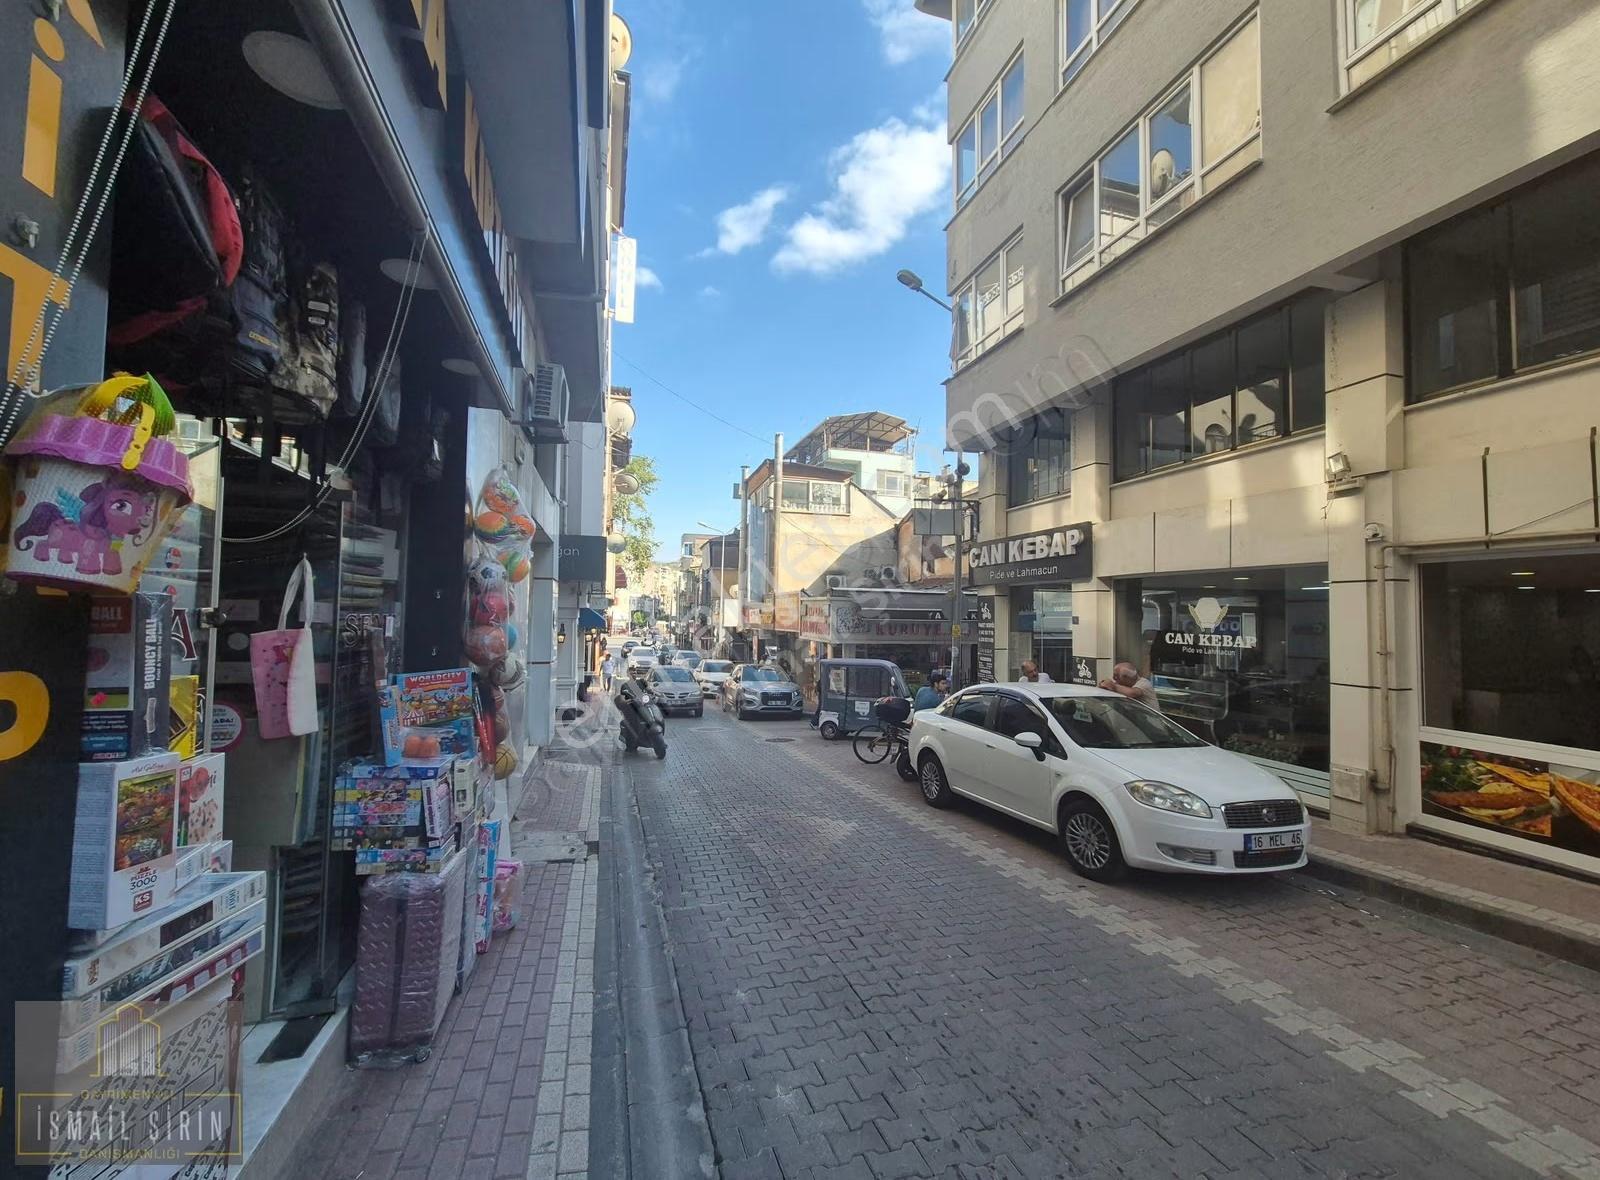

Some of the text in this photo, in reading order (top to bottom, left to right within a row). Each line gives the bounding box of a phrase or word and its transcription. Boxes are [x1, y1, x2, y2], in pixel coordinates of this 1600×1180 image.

[969, 529, 1084, 568] CAN KEBAP
[989, 565, 1058, 579] Pide ve Lahmacun
[1165, 632, 1257, 648] CAN KEBAP
[144, 618, 157, 690] BOUNCY BALL
[1182, 646, 1194, 654] Pide
[1254, 836, 1263, 849] 16
[1269, 834, 1286, 847] MEL
[129, 874, 158, 891] 3000
